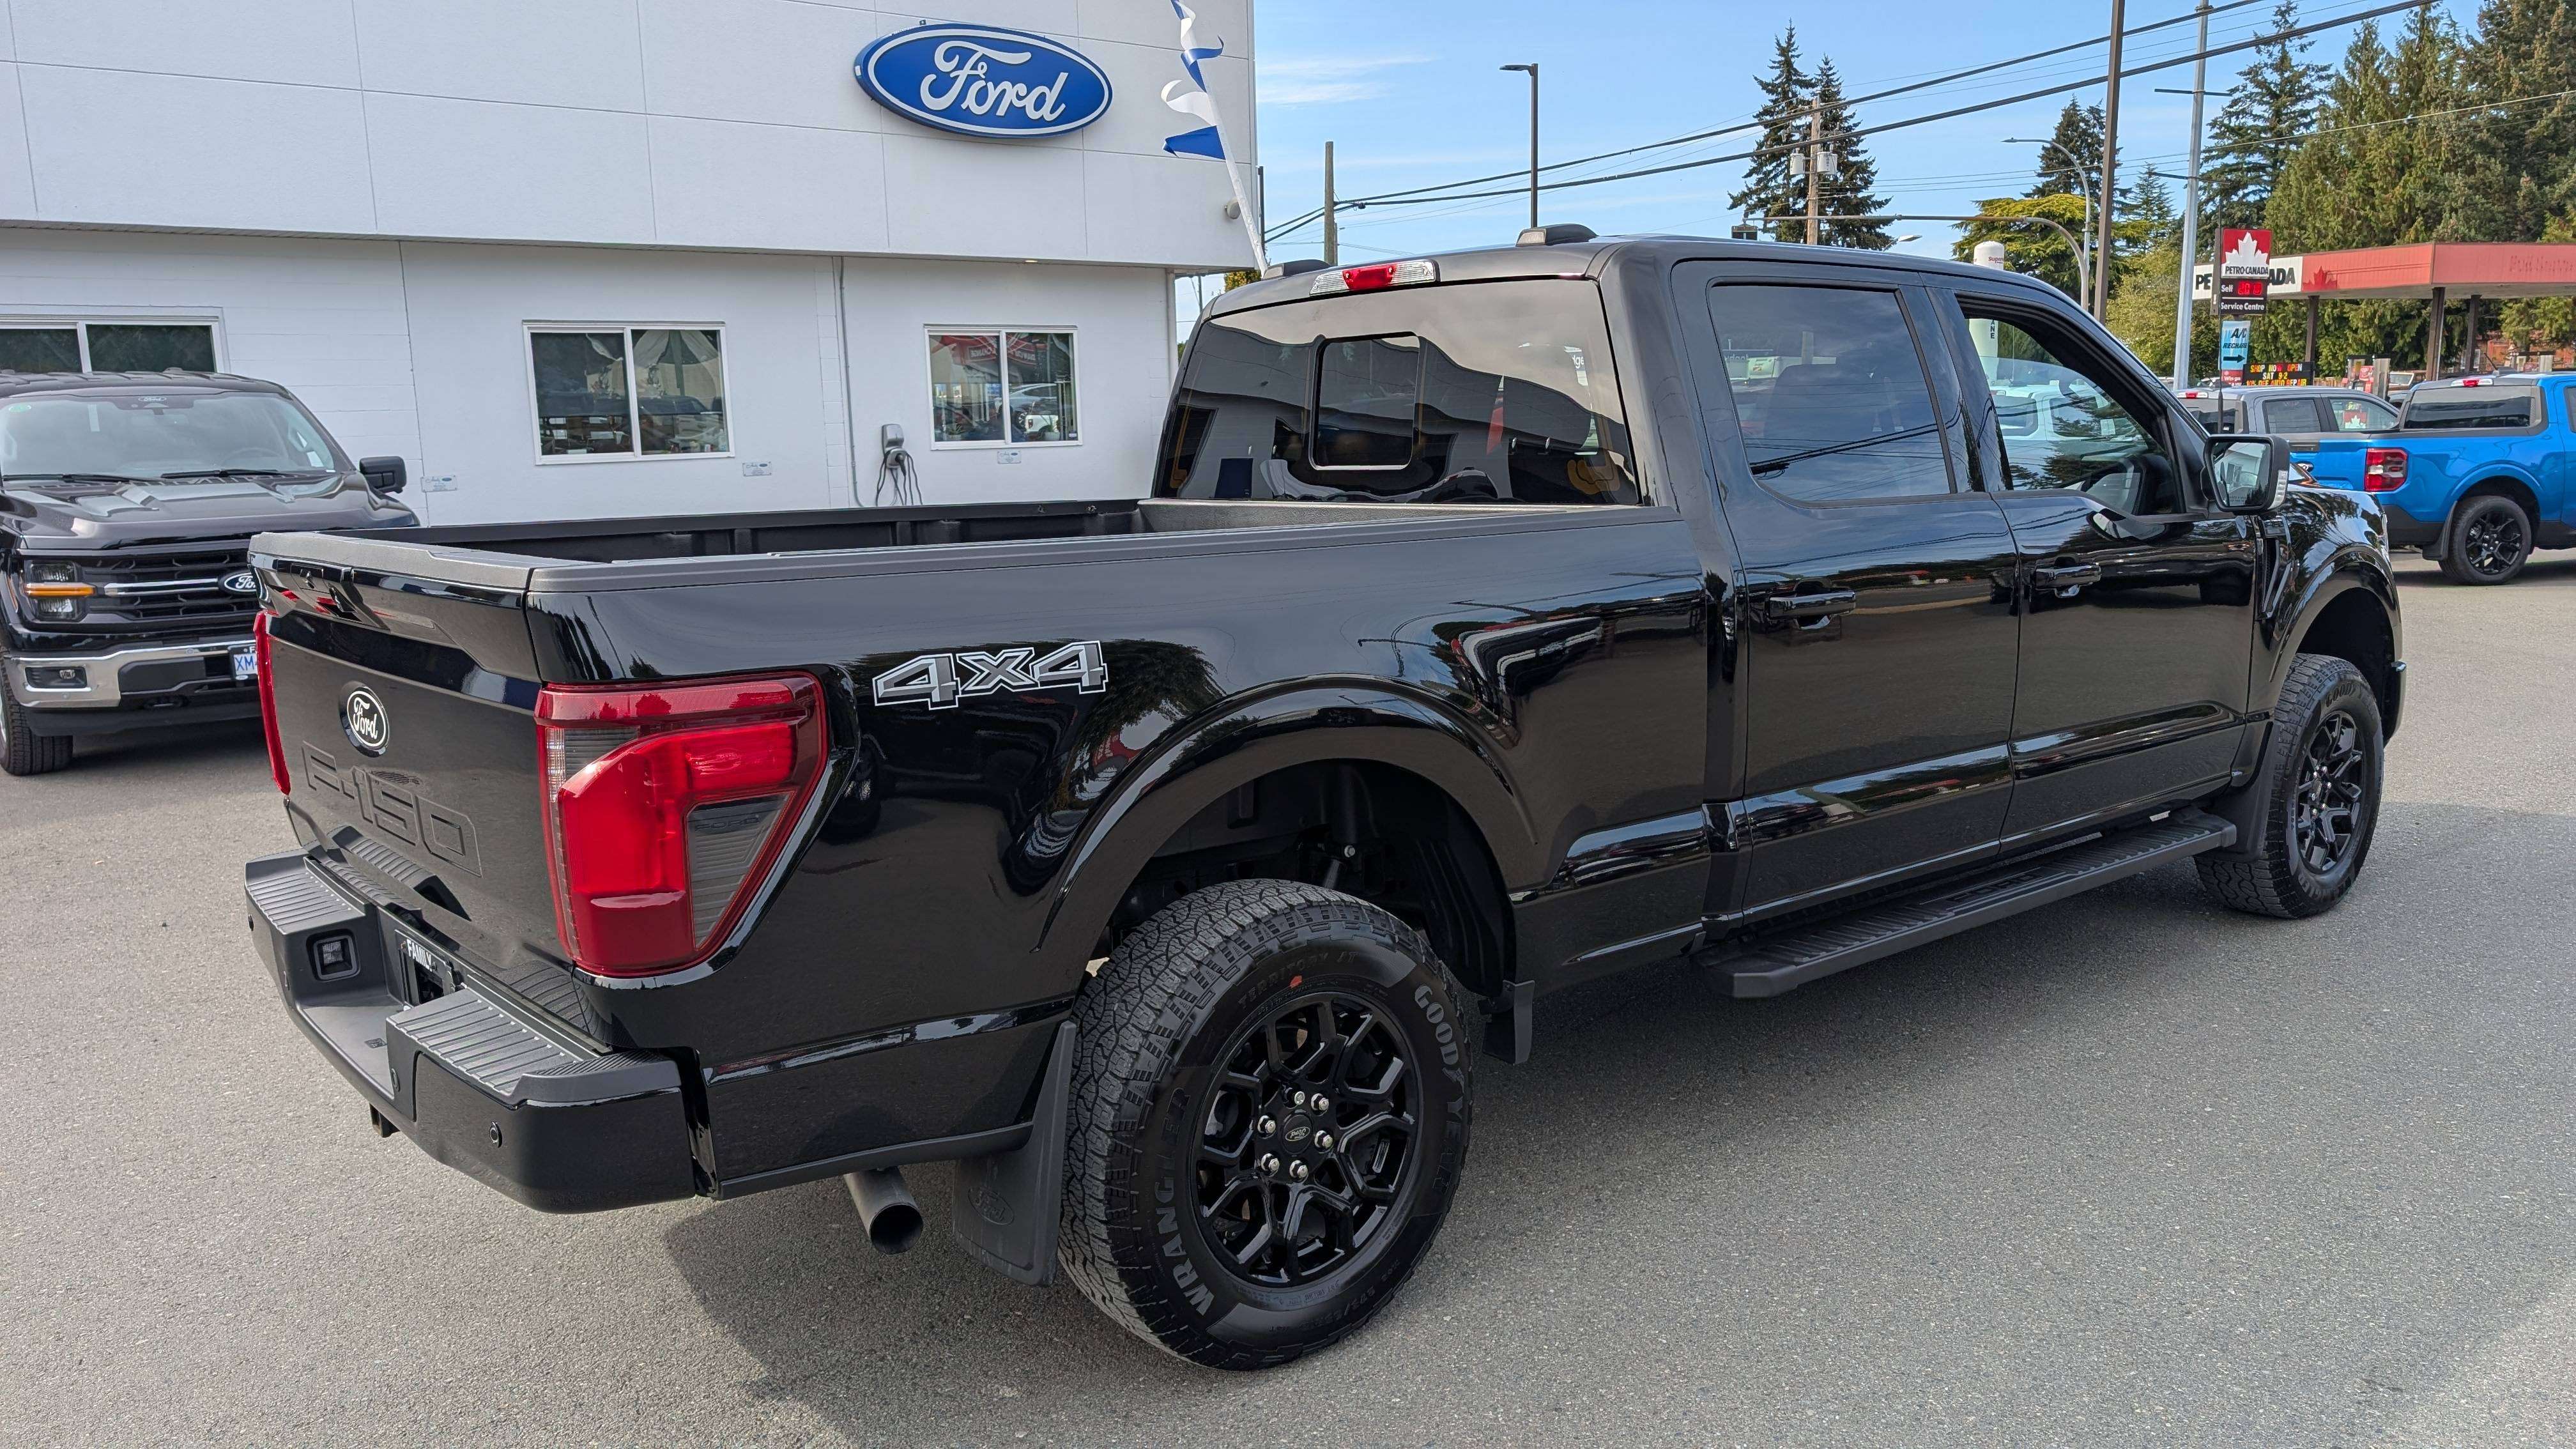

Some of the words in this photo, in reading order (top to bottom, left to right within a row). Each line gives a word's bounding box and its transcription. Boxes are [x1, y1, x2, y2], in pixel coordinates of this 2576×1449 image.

[920, 40, 1068, 121] Ford
[2225, 266, 2268, 275] PETRO-CANADA
[2221, 284, 2234, 293] Self
[2231, 328, 2247, 338] A/C
[2262, 372, 2274, 380] SAT
[2287, 363, 2303, 371] OPEN
[353, 697, 378, 739] Ford
[301, 740, 483, 878] F-150
[406, 939, 433, 972] FAMILY
[1414, 985, 1465, 1194] GOODYEAR
[1154, 1087, 1215, 1316] WRANGLER
